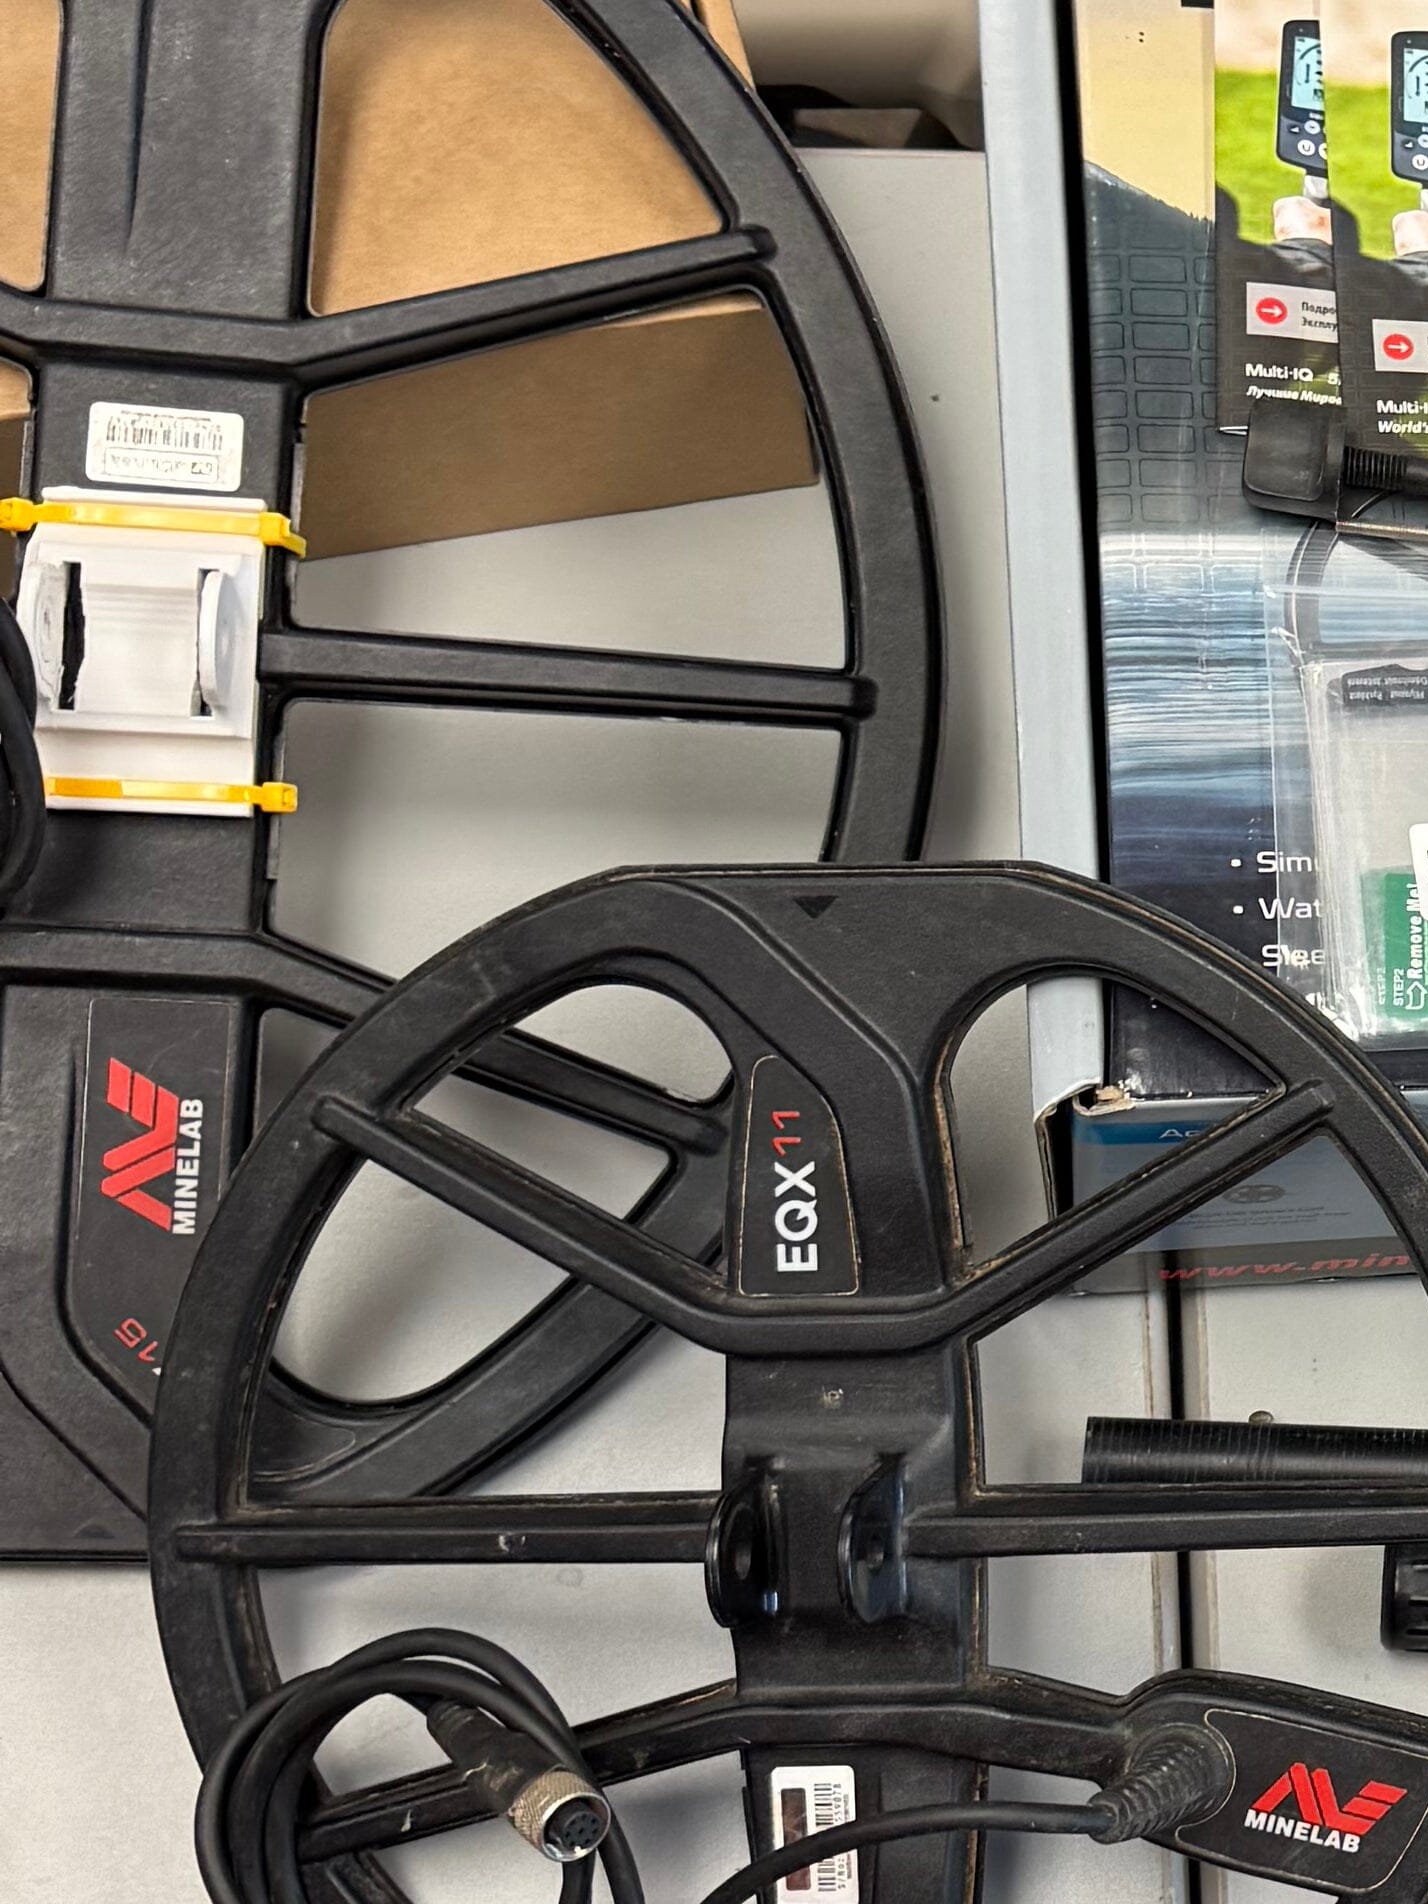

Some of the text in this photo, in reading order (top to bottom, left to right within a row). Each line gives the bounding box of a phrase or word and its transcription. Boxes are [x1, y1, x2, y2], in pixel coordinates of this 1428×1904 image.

[1407, 910, 1423, 979] Remove
[1393, 968, 1405, 1006] STEP2
[172, 1098, 204, 1235] MINELAB
[1244, 1808, 1361, 1854] MINELAB
